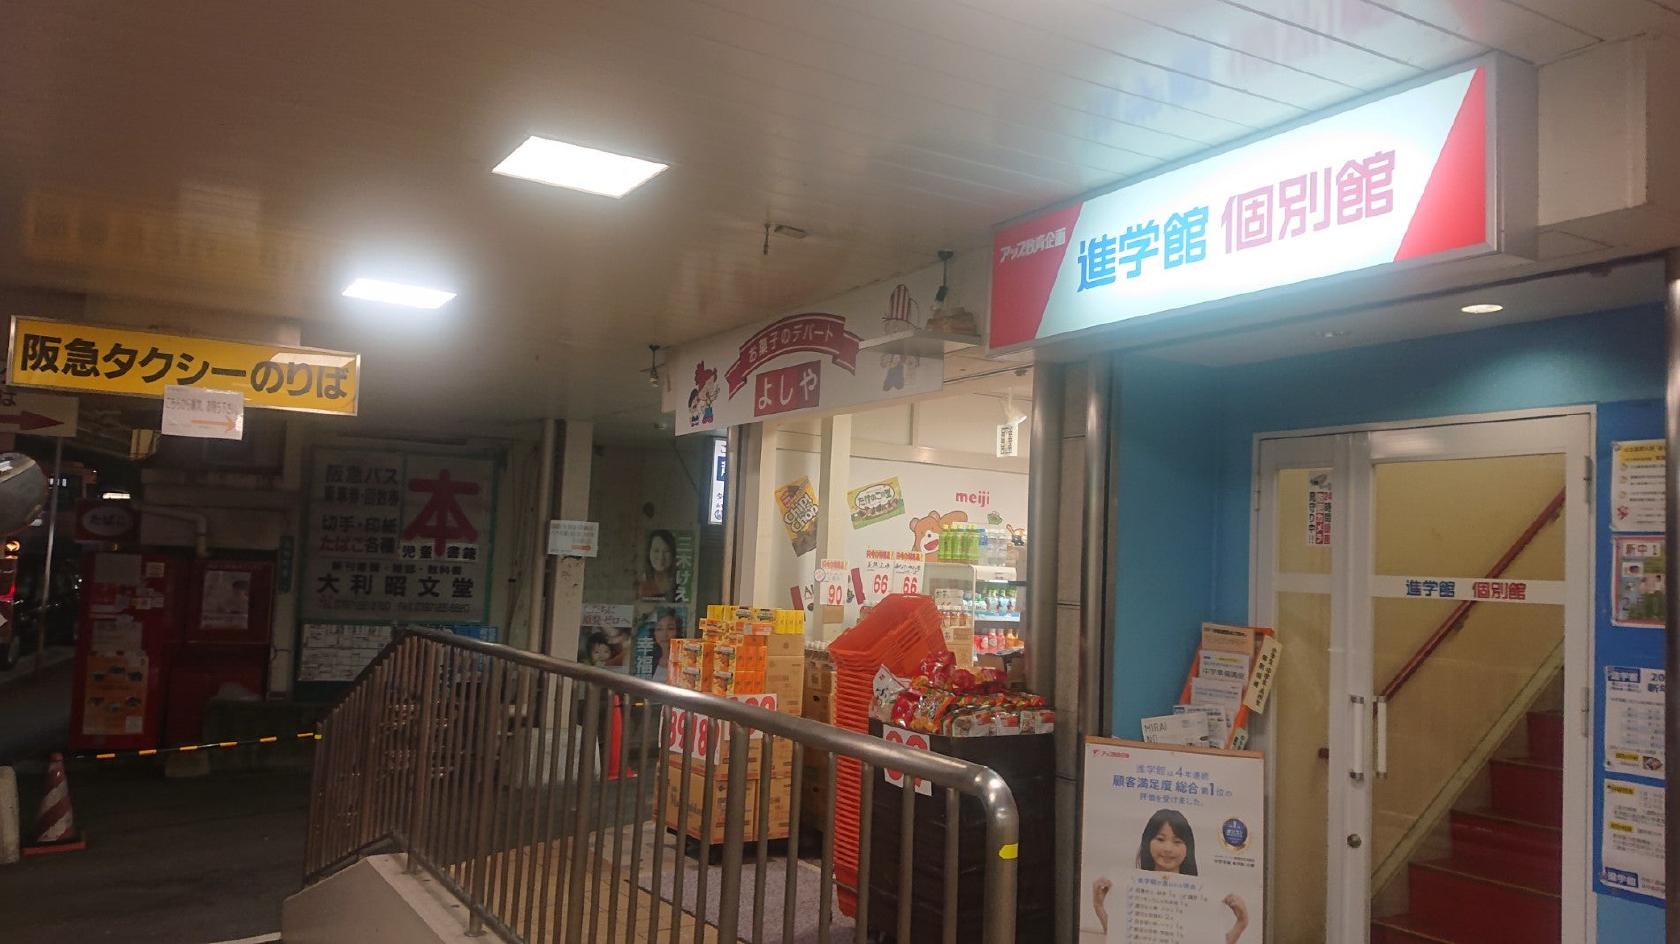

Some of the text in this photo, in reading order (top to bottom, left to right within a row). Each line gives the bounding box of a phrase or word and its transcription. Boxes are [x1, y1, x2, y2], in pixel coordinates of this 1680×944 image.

[1077, 149, 1396, 292] 進学館 個別館
[748, 325, 834, 363] お菓子のデパート
[20, 333, 349, 400] 阪急タクシーのりば
[758, 368, 818, 410] よしや
[325, 464, 398, 485] 阪急バス
[955, 490, 990, 507] meiji
[400, 468, 479, 557] 本
[319, 533, 395, 553] たばこ各種
[316, 572, 475, 597] 大利昭文堂
[828, 584, 843, 605] 90
[873, 574, 888, 594] 66
[903, 576, 918, 594] 66
[1406, 579, 1526, 601] 進学館 個別館
[1112, 774, 1173, 792] 顧客満足度
